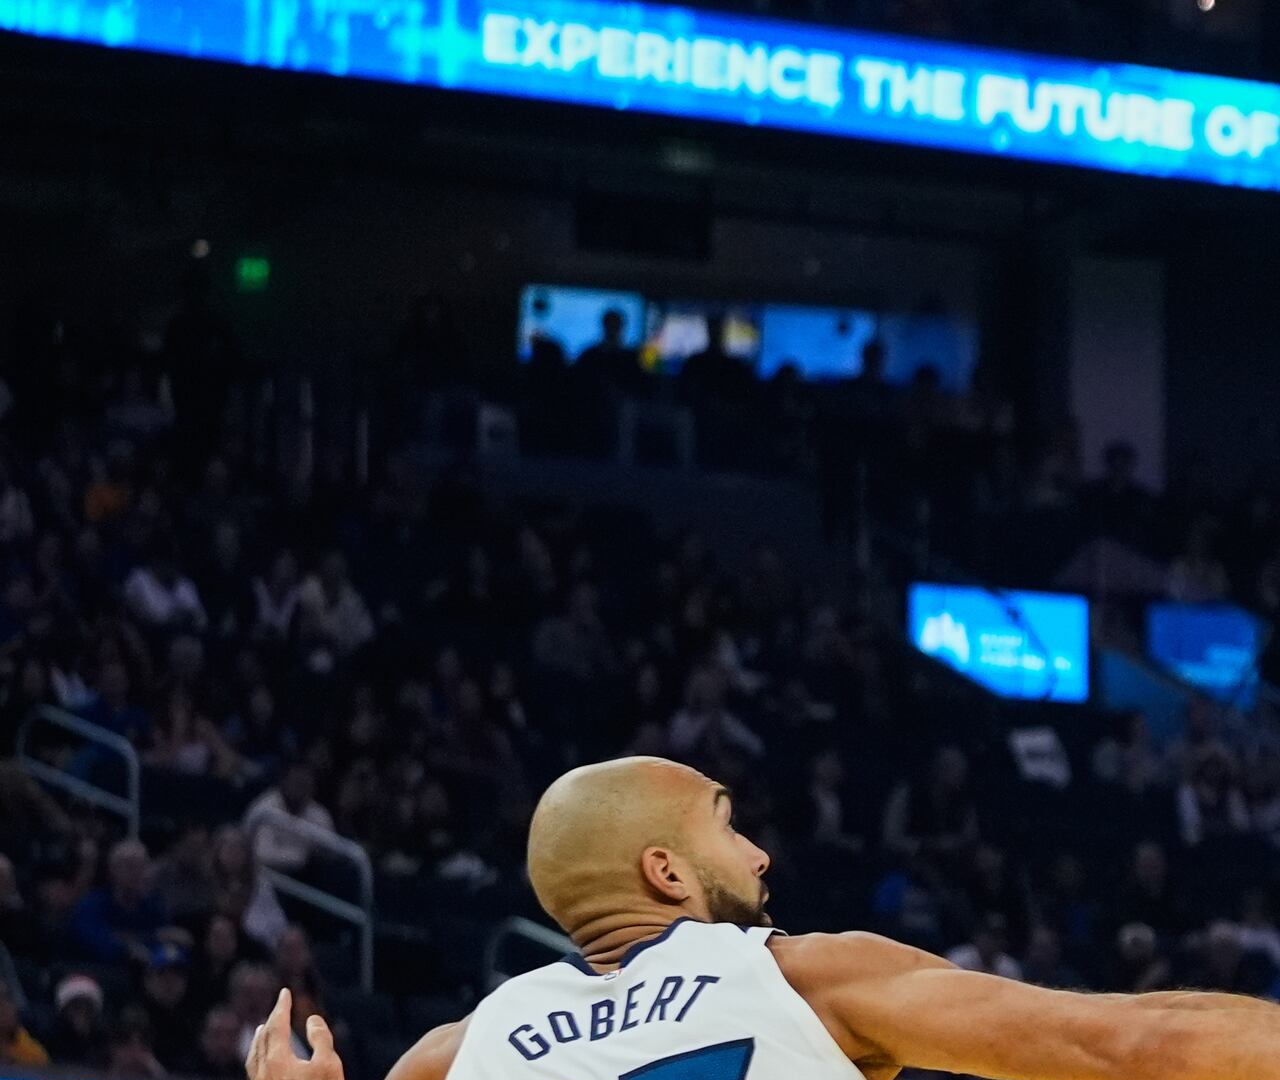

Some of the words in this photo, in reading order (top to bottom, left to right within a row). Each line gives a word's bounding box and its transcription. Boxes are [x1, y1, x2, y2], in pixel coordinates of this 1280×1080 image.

[482, 14, 841, 105] EXPERIENCE
[855, 58, 966, 122] THE
[976, 74, 1195, 151] FUTURE
[1205, 104, 1280, 159] OF
[508, 975, 721, 1061] GOBERT
